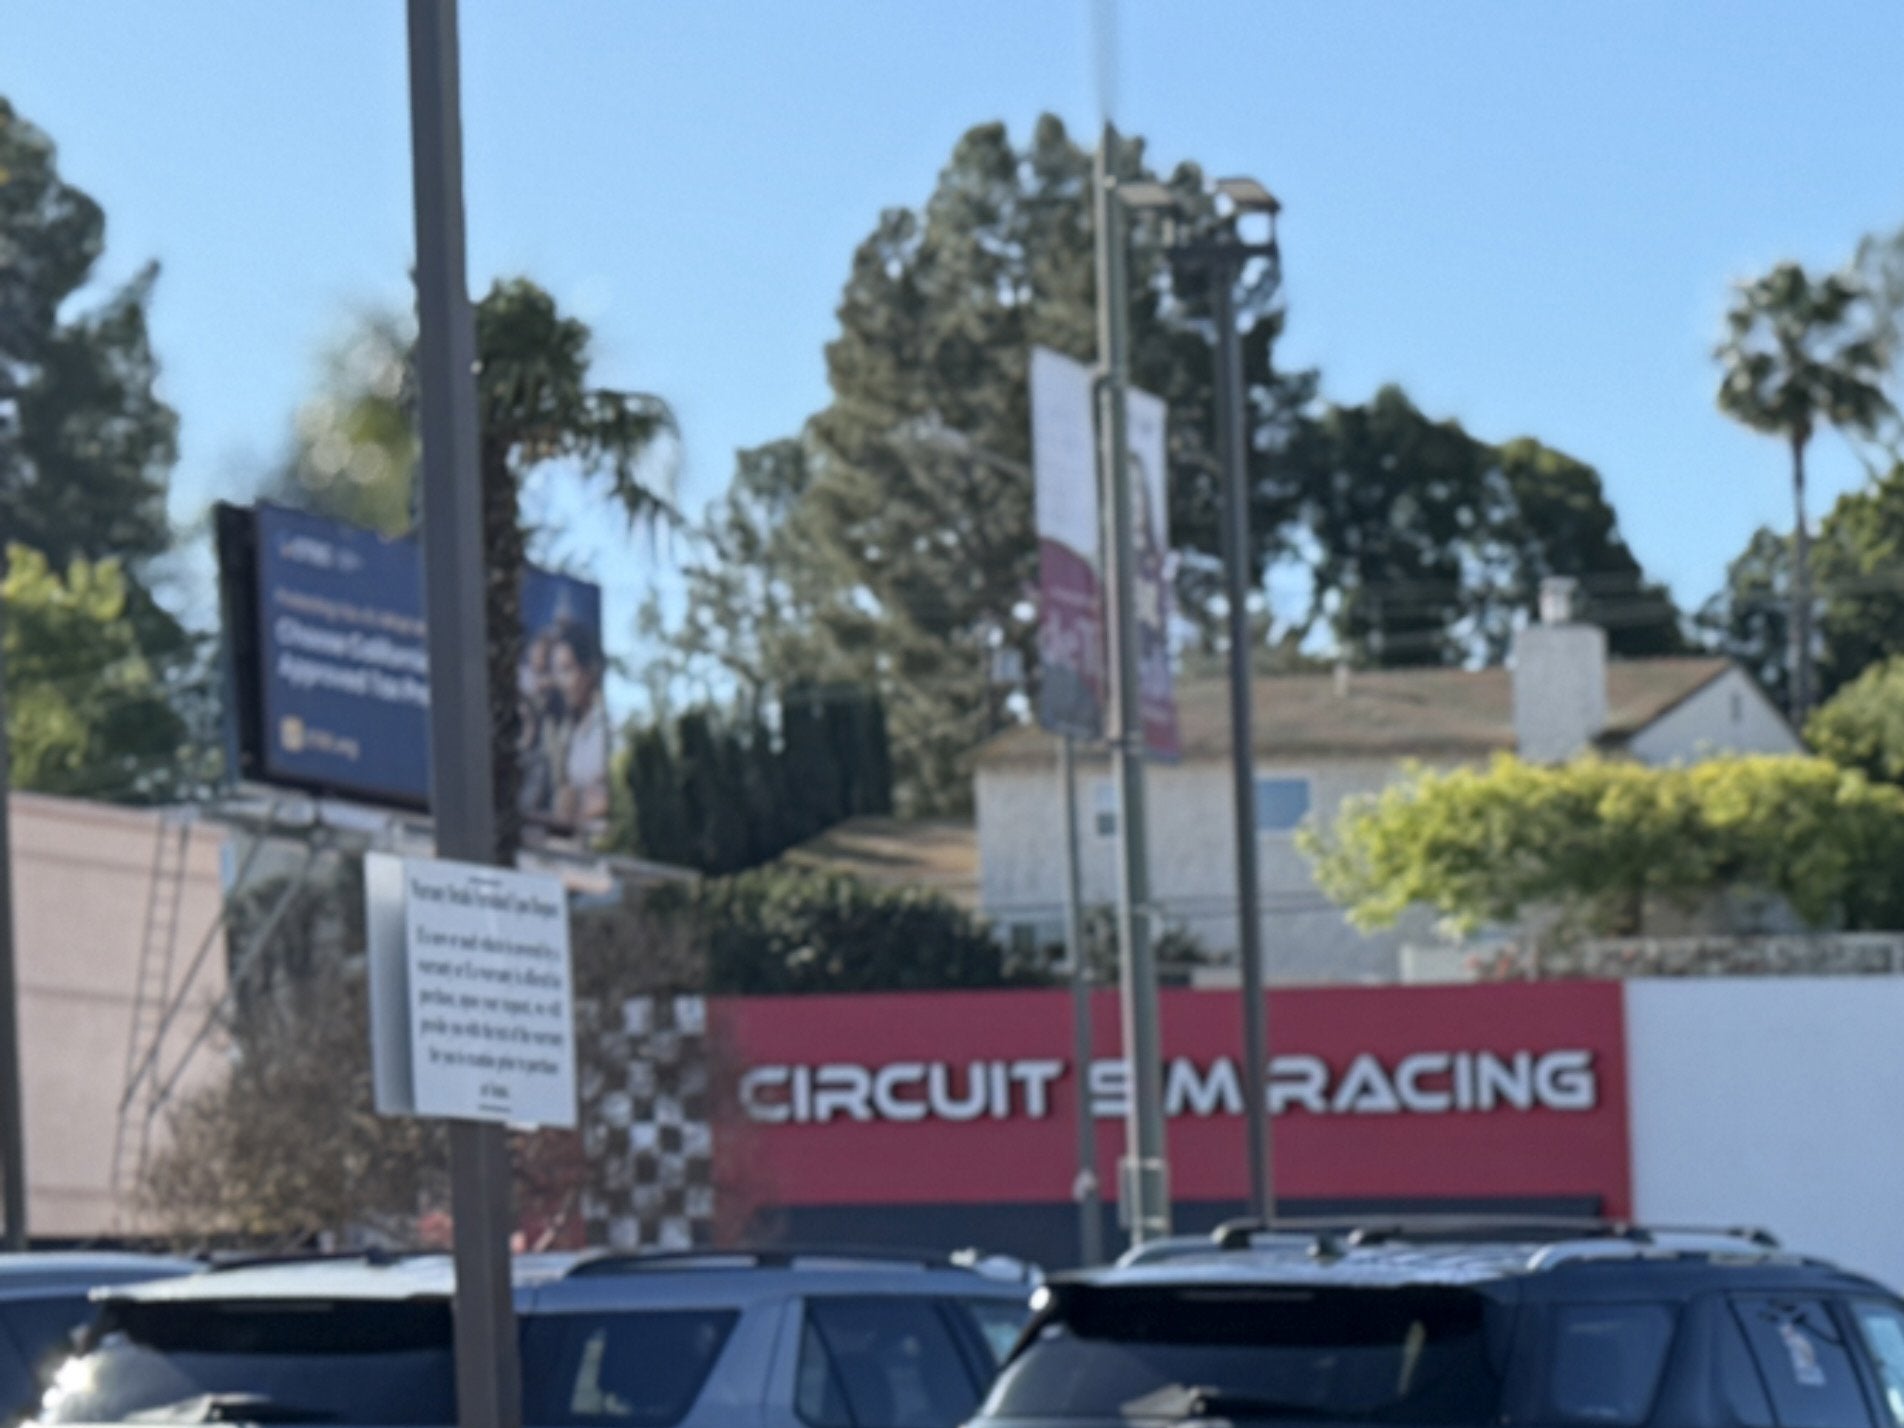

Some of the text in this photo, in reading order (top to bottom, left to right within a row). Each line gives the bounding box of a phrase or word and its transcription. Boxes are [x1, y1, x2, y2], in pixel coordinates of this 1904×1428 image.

[740, 1050, 1596, 1121] CIRCUIT SM RACING
